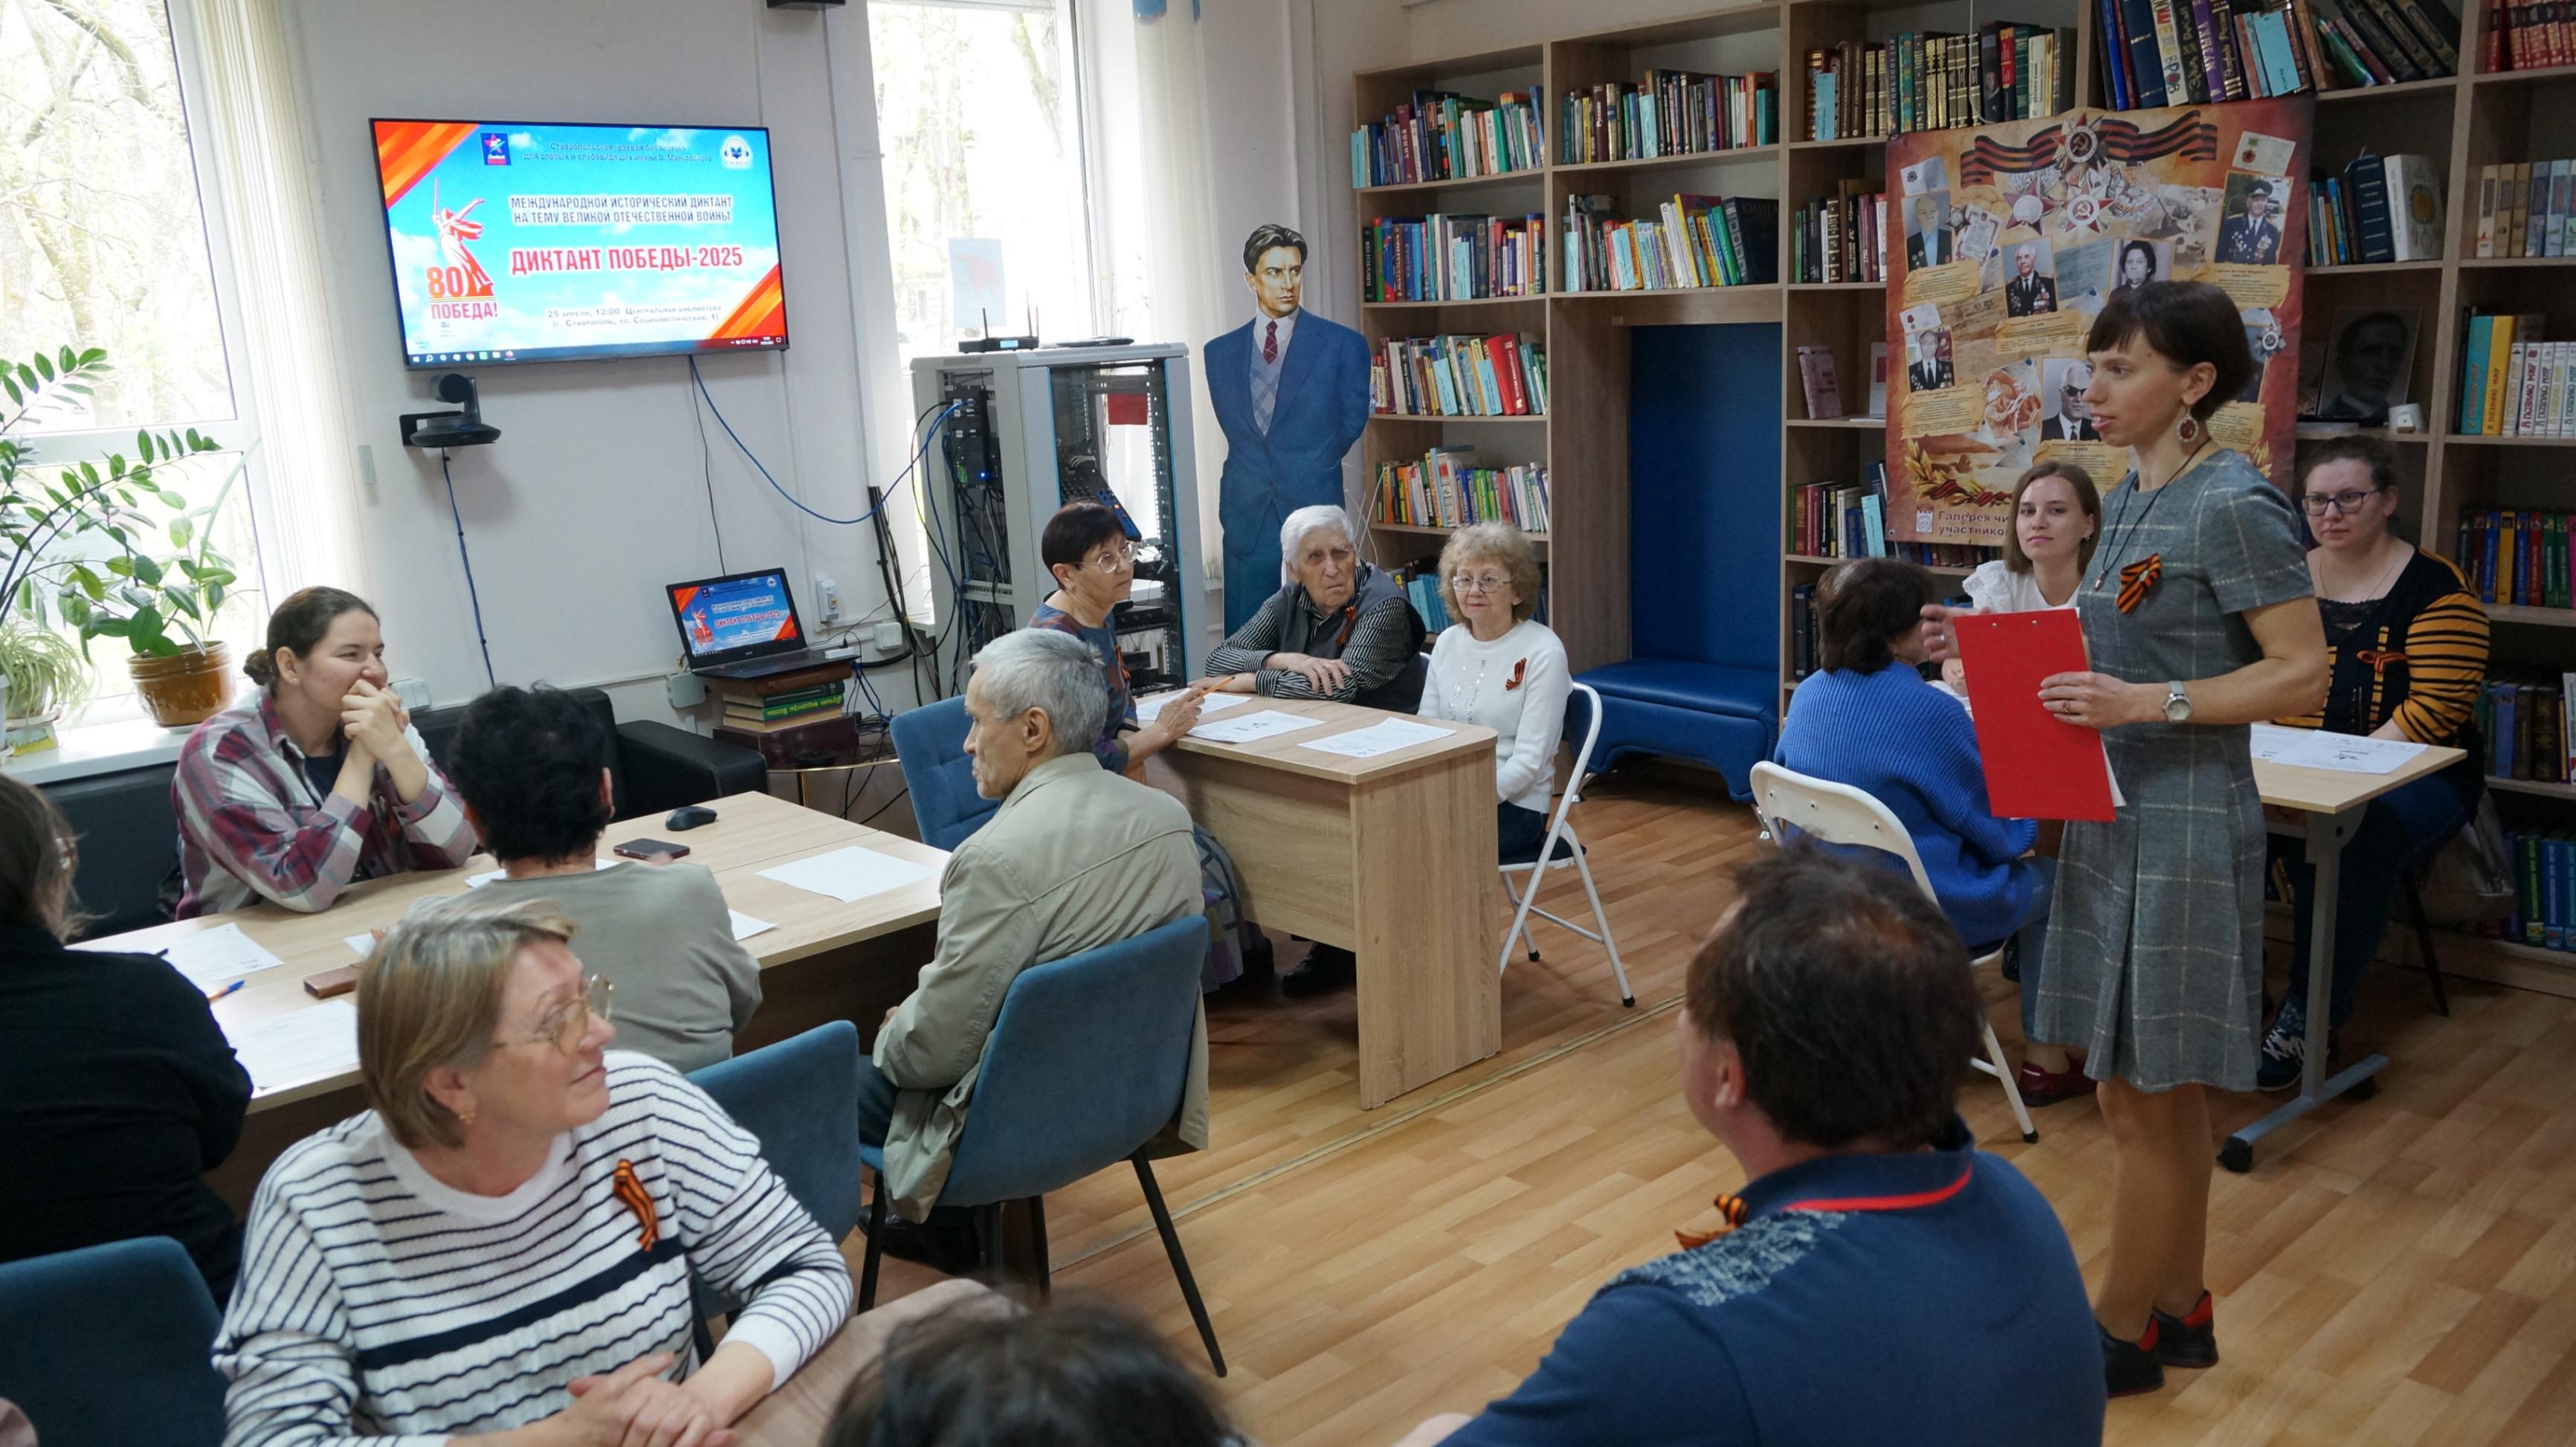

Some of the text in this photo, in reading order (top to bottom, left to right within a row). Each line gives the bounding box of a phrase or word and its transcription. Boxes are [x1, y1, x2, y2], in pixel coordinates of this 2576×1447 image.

[2198, 22, 2217, 72] МУЗЫКА
[511, 196, 732, 210] МЕЖДУНАРОДНОЙ ИСТОРИЧЕСКИЙ ДИКТАНТ
[514, 209, 731, 224] НА ТЕМУ ВЕЛИКОЙ ОТЕЧЕСТВЕННОЙ ВОЙНЫ
[511, 246, 743, 275] ДИКТАНТ ПОБЕДЫ-2025
[427, 265, 463, 297] 80
[430, 302, 499, 320] ПОБЕДА!
[2526, 362, 2537, 381] МИР
[2523, 384, 2535, 419] ПОЗНАЮ
[1938, 510, 1990, 523] Галерея
